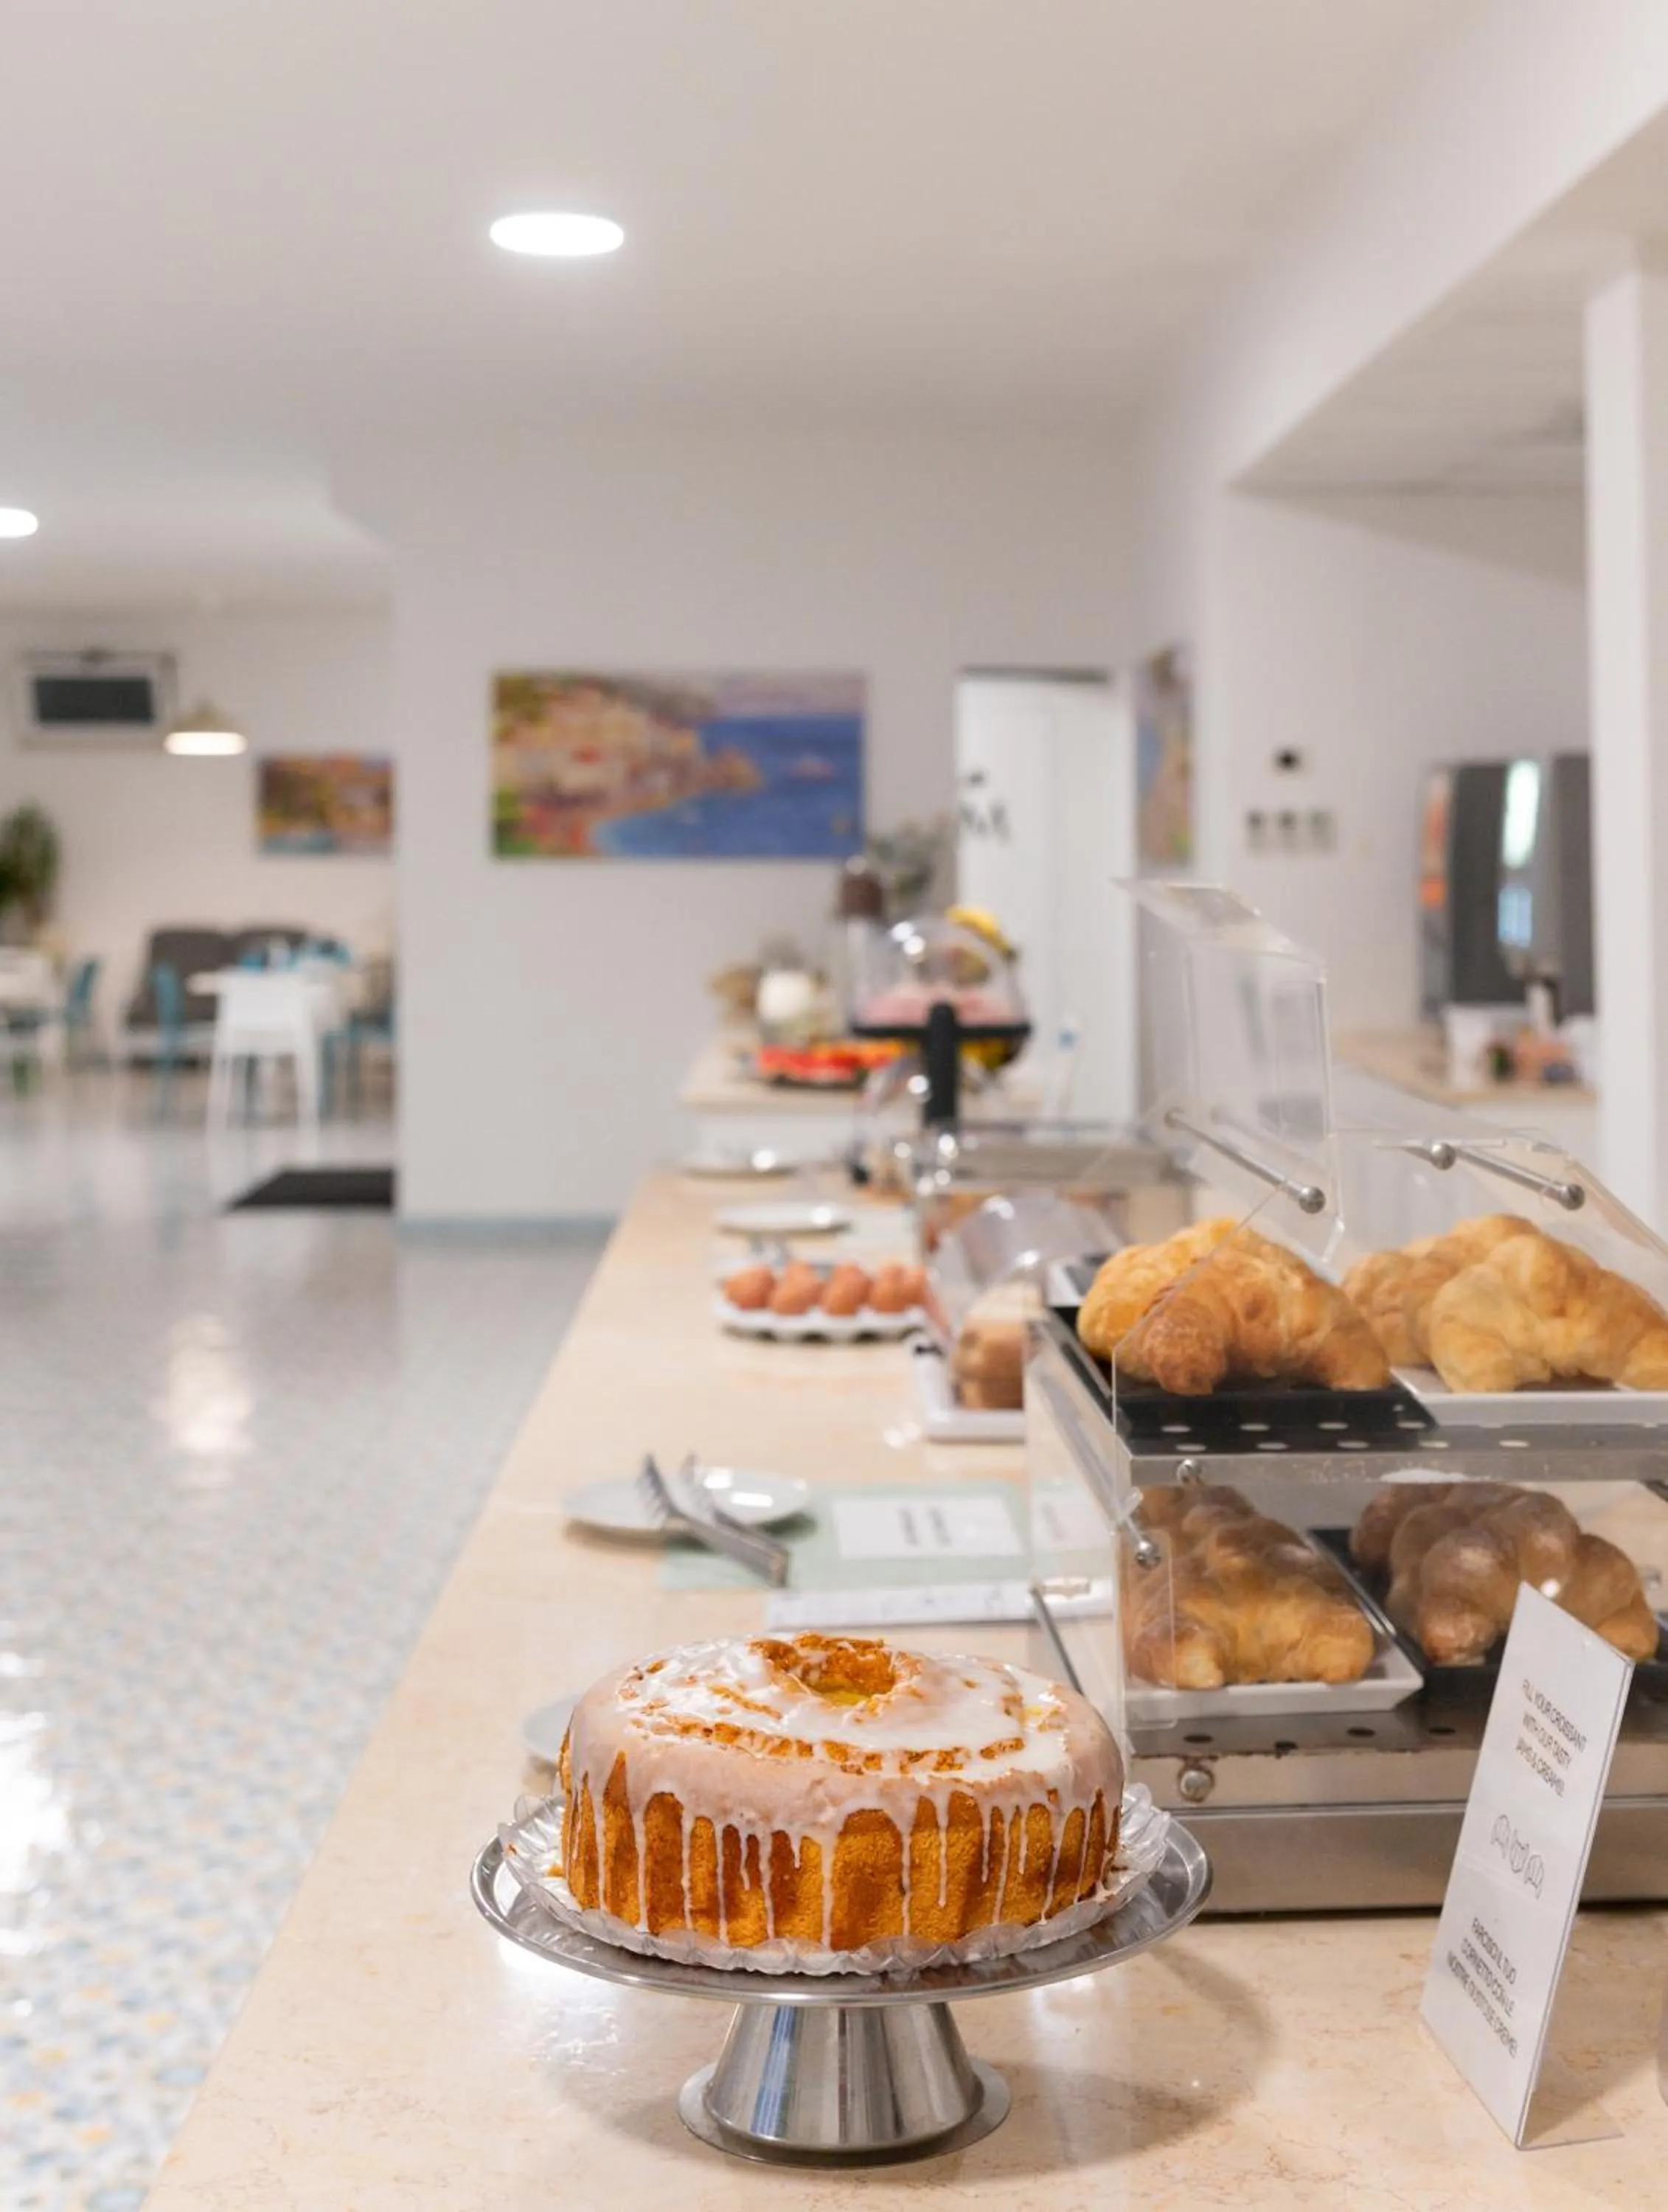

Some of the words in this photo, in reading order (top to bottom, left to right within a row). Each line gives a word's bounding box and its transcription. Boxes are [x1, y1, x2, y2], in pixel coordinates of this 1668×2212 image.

[1532, 1688, 1552, 1719] YOUR
[1549, 1705, 1588, 1754] CROISSANT
[1536, 1724, 1554, 1753] OUR
[1501, 1955, 1518, 1988] TUO
